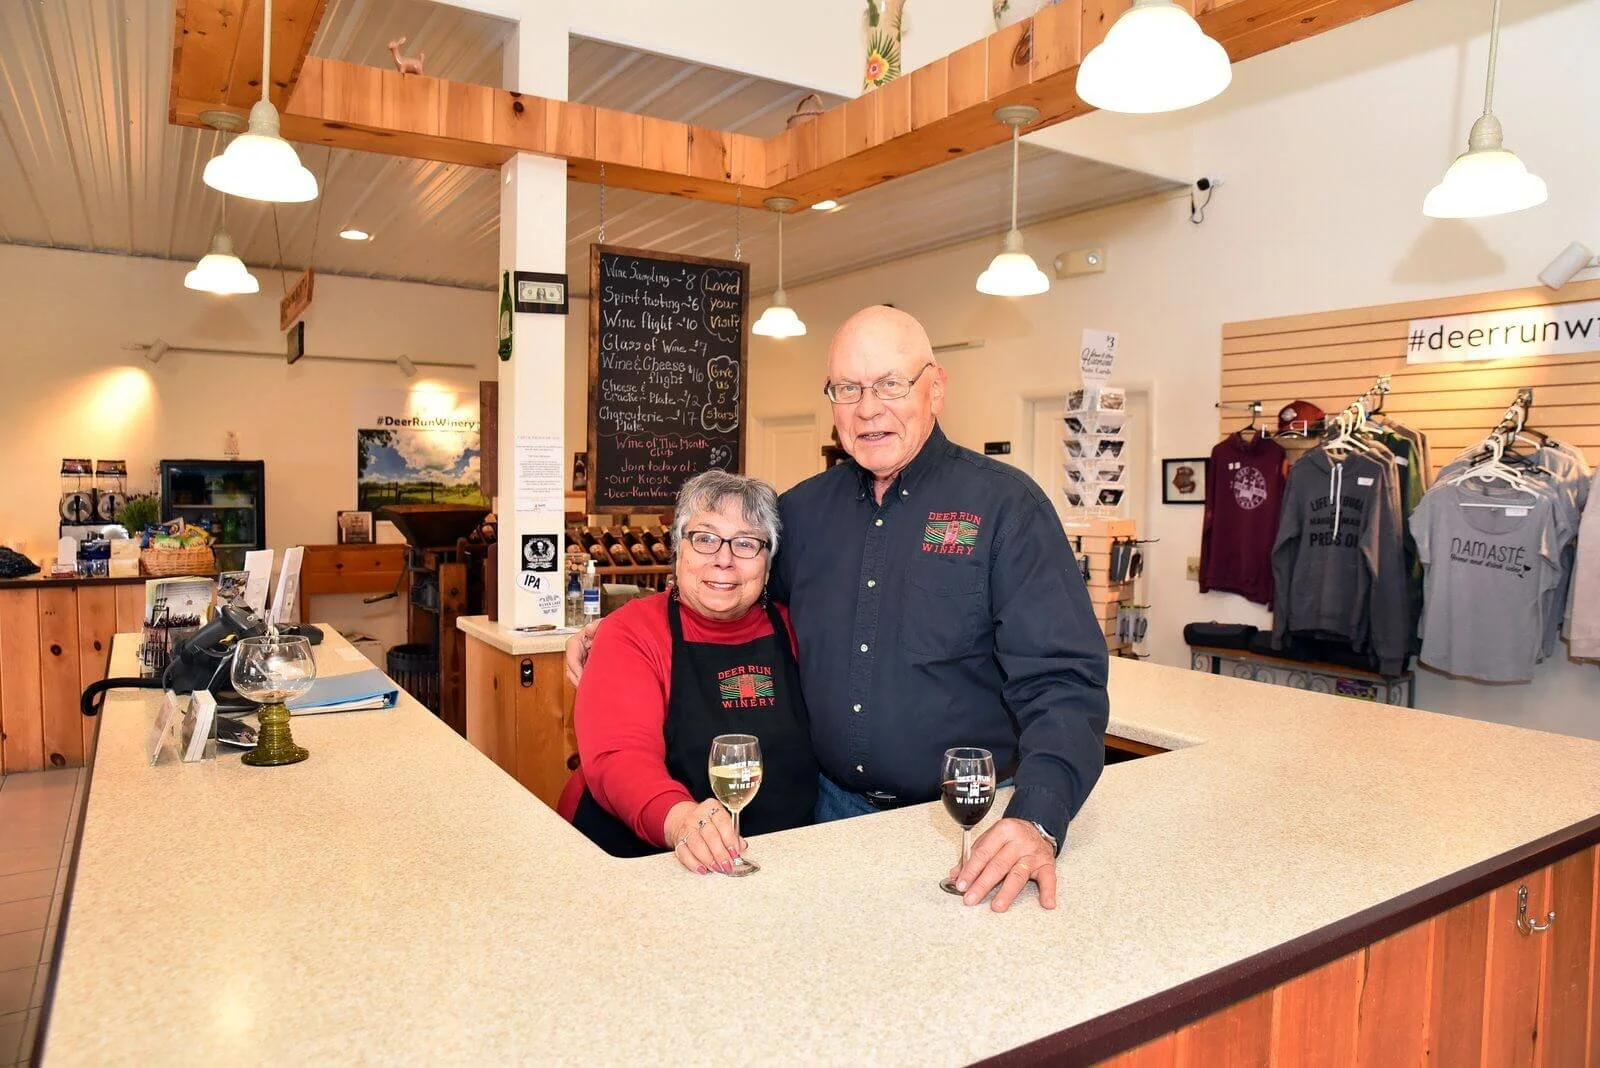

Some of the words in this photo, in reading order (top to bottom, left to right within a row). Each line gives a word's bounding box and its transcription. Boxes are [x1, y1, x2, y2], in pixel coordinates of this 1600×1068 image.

[602, 257, 627, 279] Wine
[629, 261, 670, 288] Sampling
[705, 274, 740, 295] Loved
[603, 286, 640, 306] Spirit
[642, 290, 680, 313] tasting
[710, 298, 738, 311] your
[603, 309, 636, 329] Wine
[641, 311, 673, 334] flight
[1409, 317, 1600, 351] #deerrunw
[602, 333, 641, 351] Glass
[643, 337, 658, 351] of
[662, 339, 687, 354] Wine
[601, 352, 633, 371] Wine
[643, 355, 686, 373] Cheese
[710, 365, 734, 379] Give
[602, 378, 640, 392] Cheese
[649, 371, 684, 389] flight
[716, 381, 730, 390] us
[649, 391, 676, 405] Plate
[718, 393, 726, 404] 5
[599, 405, 664, 423] Charcuterie
[377, 416, 475, 430] #DeerRunWinery
[615, 435, 644, 449] Wine
[646, 438, 658, 449] of
[658, 438, 678, 449] The
[621, 458, 645, 472] Join
[648, 460, 678, 472] today
[638, 474, 672, 484] Kiosk
[928, 511, 957, 521] DEER
[959, 511, 982, 525] RUN
[922, 543, 974, 556] WINERY
[524, 574, 541, 590] IPA
[718, 666, 746, 680] DEER
[748, 665, 772, 676] RUN
[722, 697, 776, 709] WINERY
[956, 796, 990, 804] WINERY
